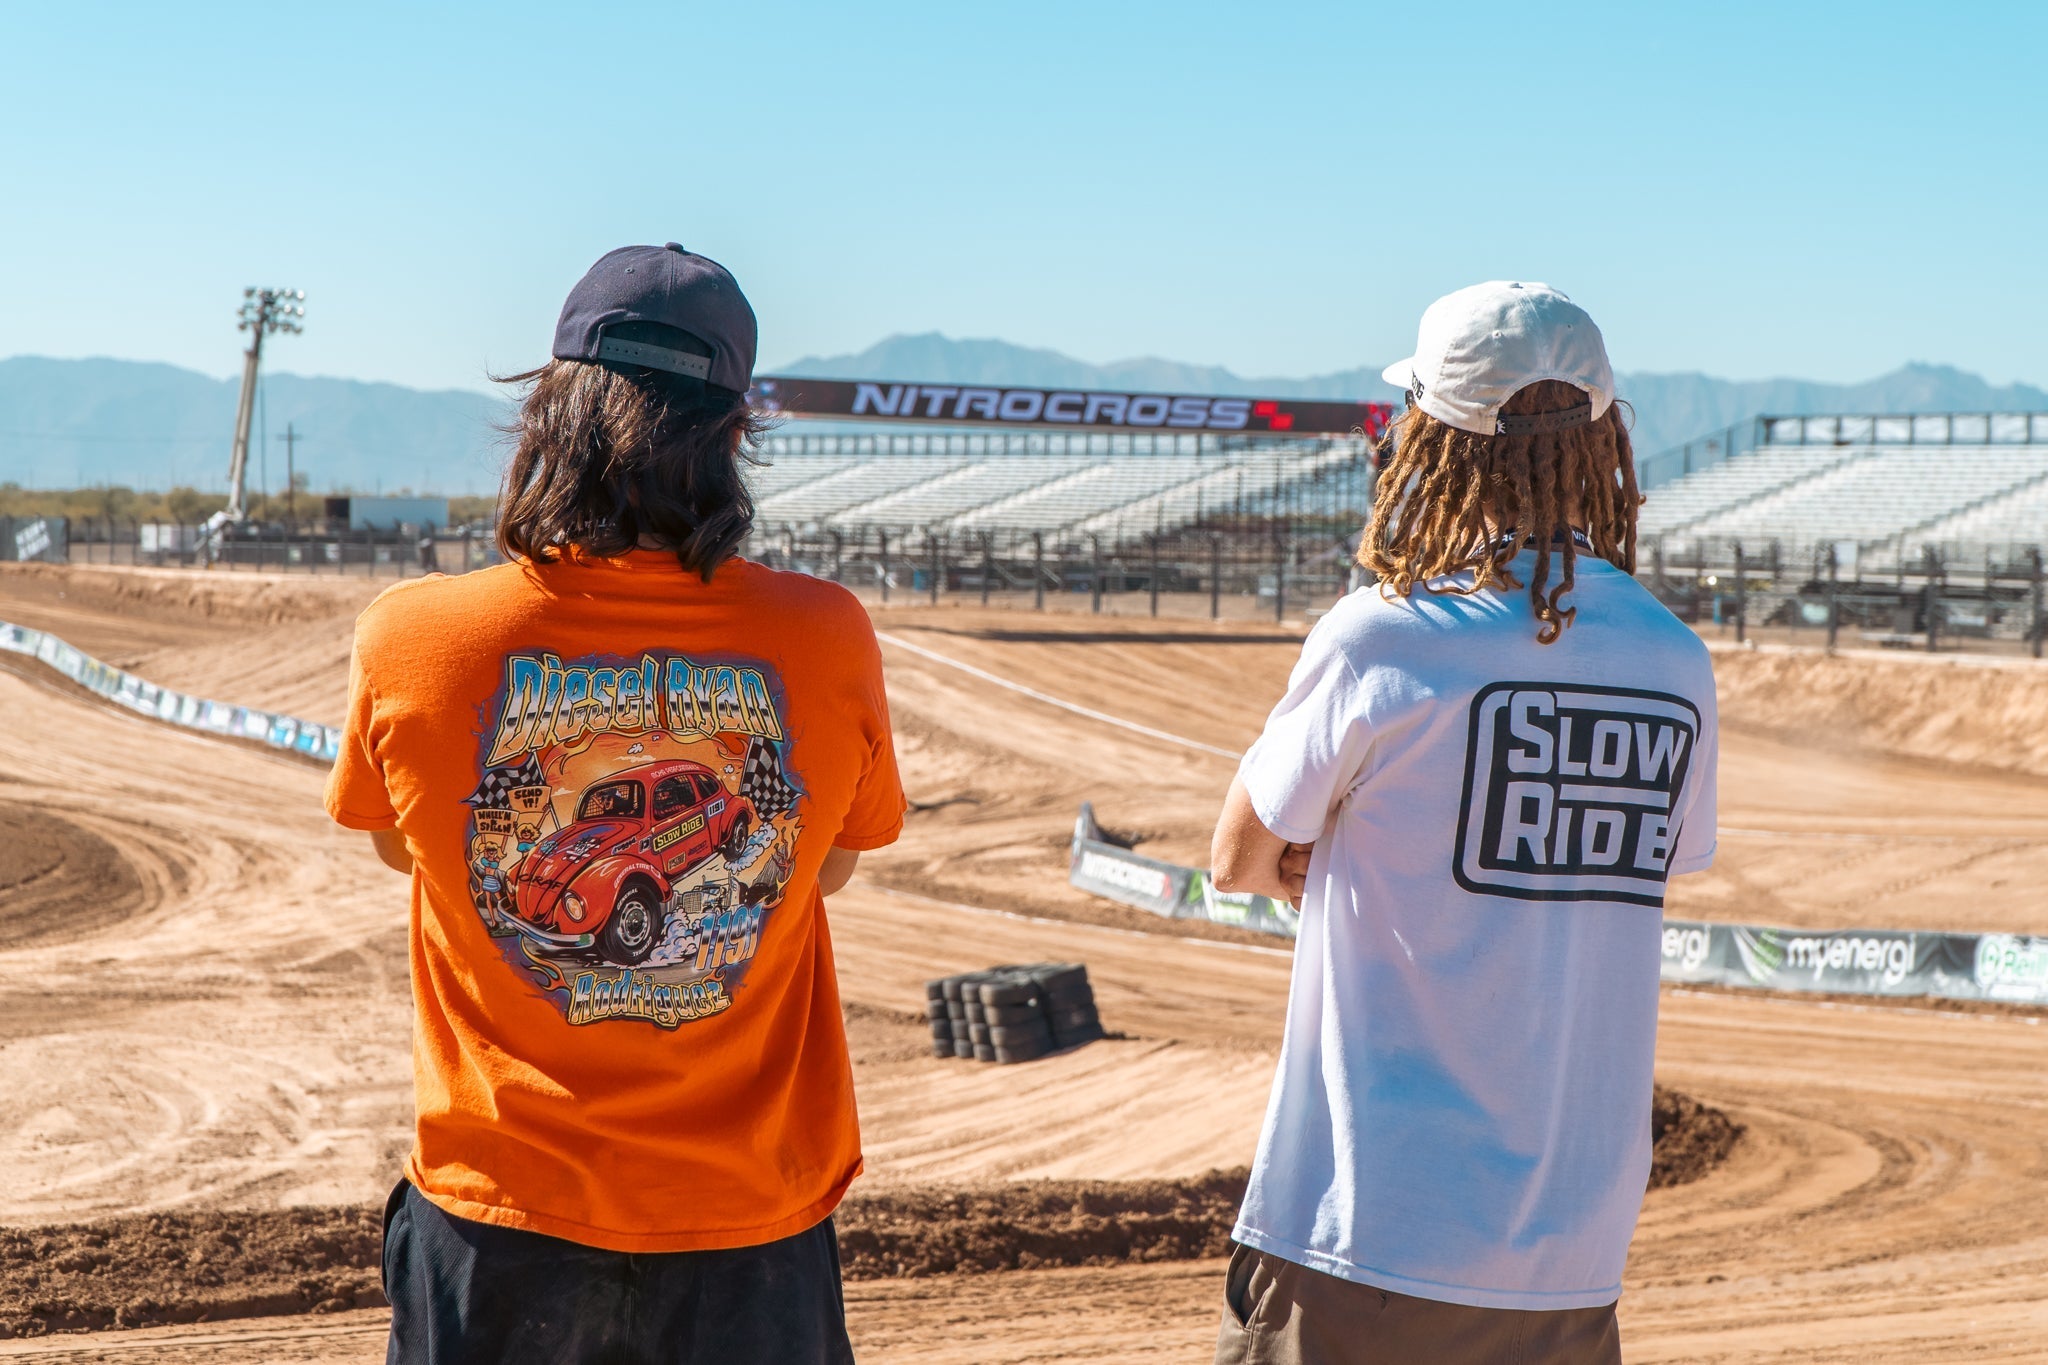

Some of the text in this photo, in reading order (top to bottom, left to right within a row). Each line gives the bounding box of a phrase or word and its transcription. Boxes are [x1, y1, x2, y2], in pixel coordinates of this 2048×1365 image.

[852, 383, 1253, 429] NITROCROSS
[486, 653, 783, 767] Diesel Ryan
[1507, 690, 1688, 783] SLOW
[514, 788, 543, 799] SEND
[522, 797, 539, 808] IT!
[709, 801, 723, 815] 1191
[656, 825, 680, 847] SLOW
[681, 817, 702, 835] RIDE
[1496, 781, 1668, 872] RIDE
[695, 903, 765, 970] 1191
[1662, 923, 1711, 972] ergi
[1787, 932, 1917, 986] myenergi
[568, 970, 731, 1027] Rodriguez
